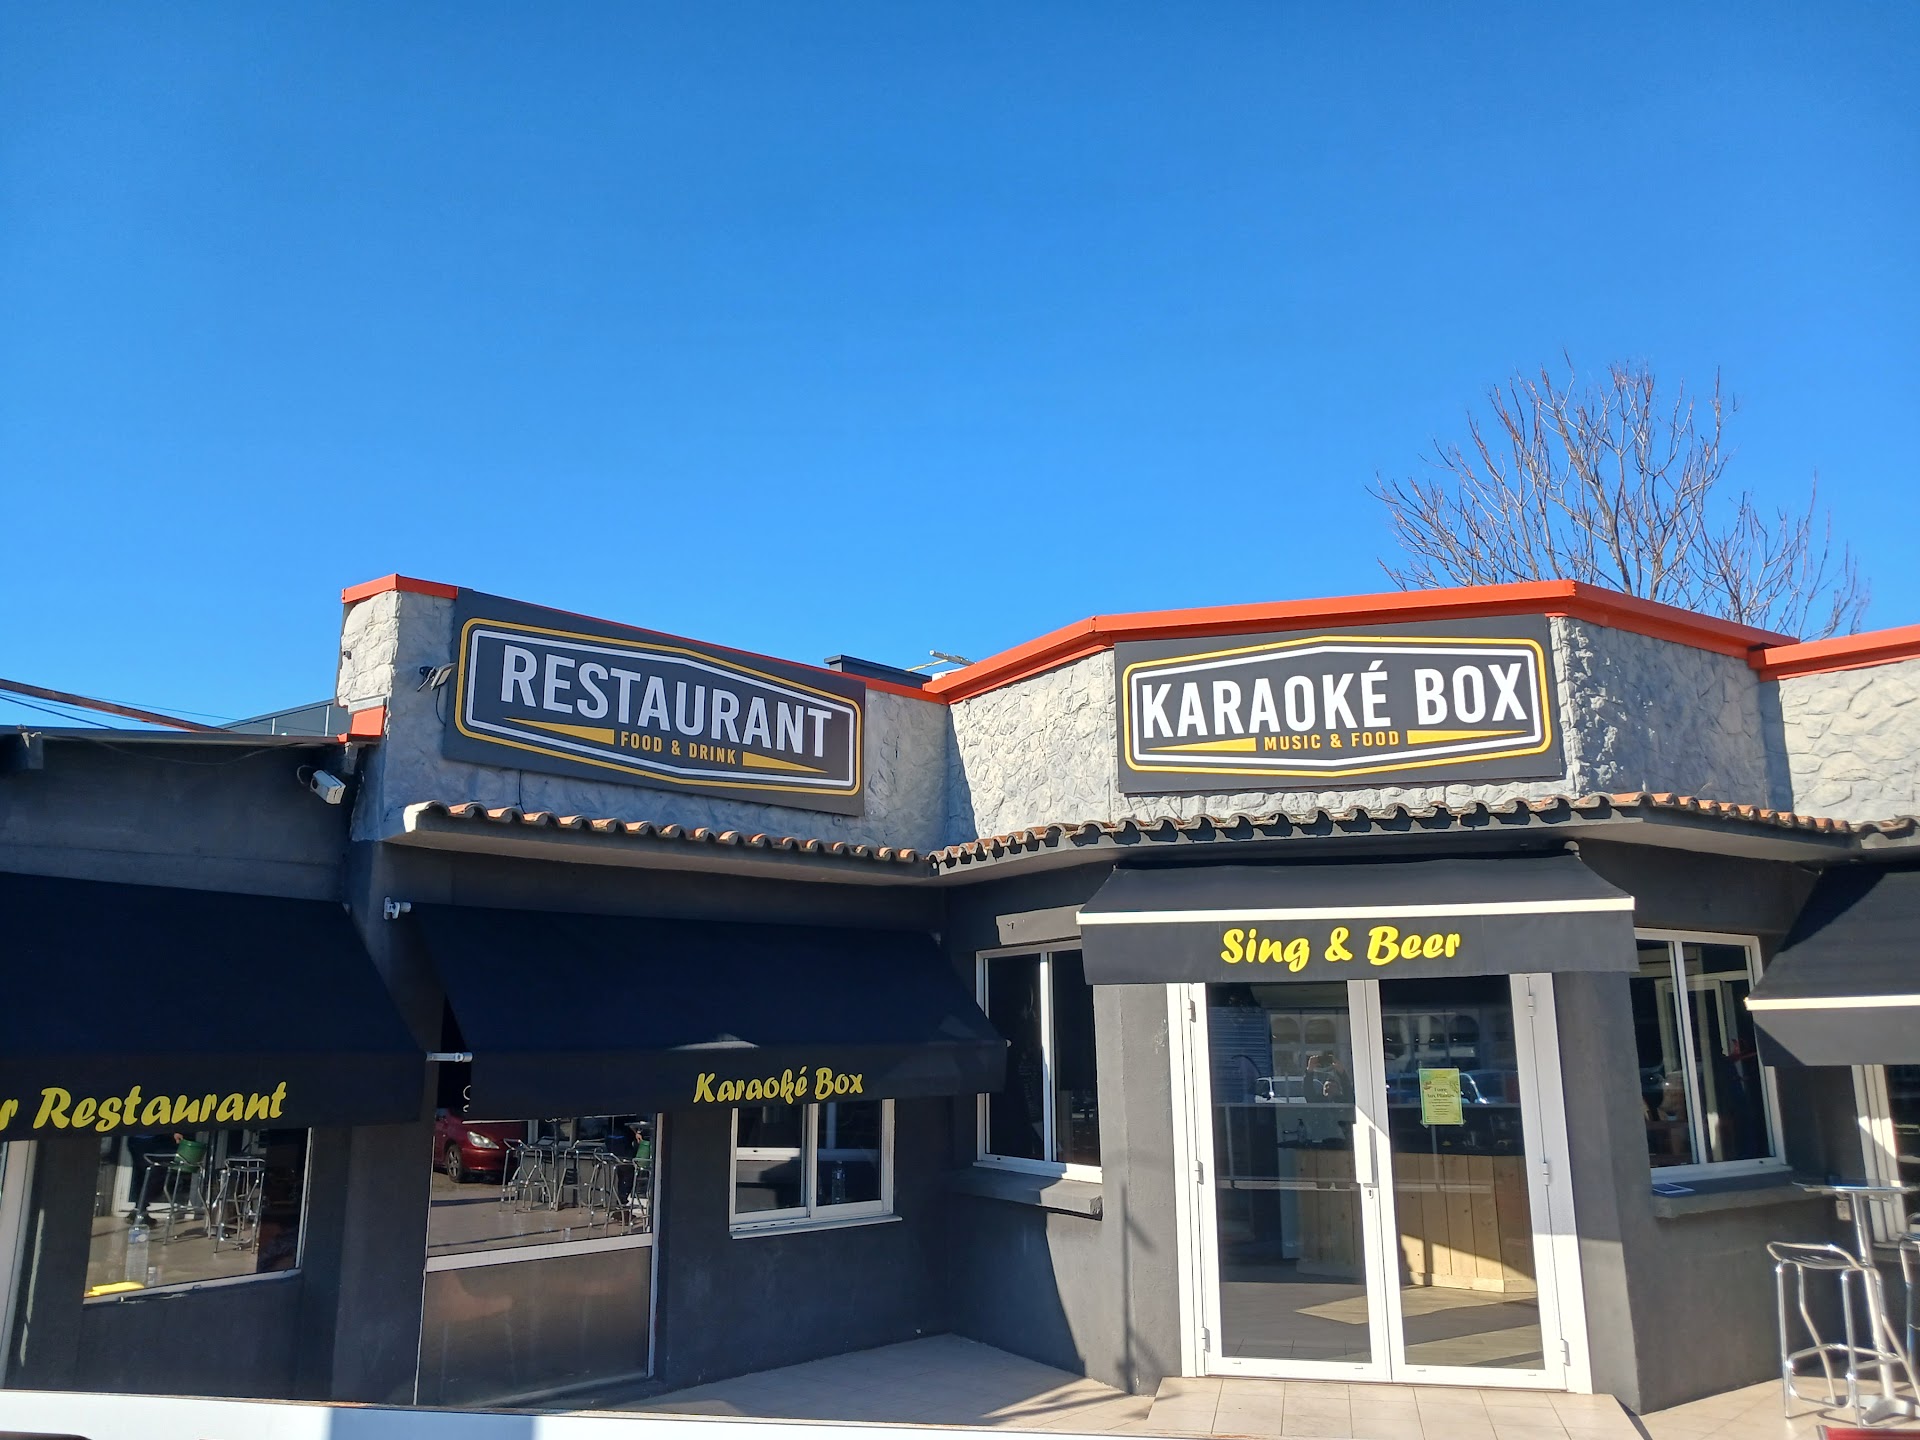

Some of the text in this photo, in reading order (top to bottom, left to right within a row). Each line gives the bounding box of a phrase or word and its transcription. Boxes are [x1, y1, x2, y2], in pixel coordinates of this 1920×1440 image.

[501, 644, 832, 758] RESTAURANT
[1141, 659, 1528, 739] KARAOKÉ BOX
[620, 730, 738, 765] FOOD & DRINK
[1263, 730, 1401, 751] MUSIC & FOOD
[1219, 924, 1462, 973] Sing & Beer
[33, 1081, 287, 1133] Restaurant
[693, 1065, 863, 1105] Karaoké Box
